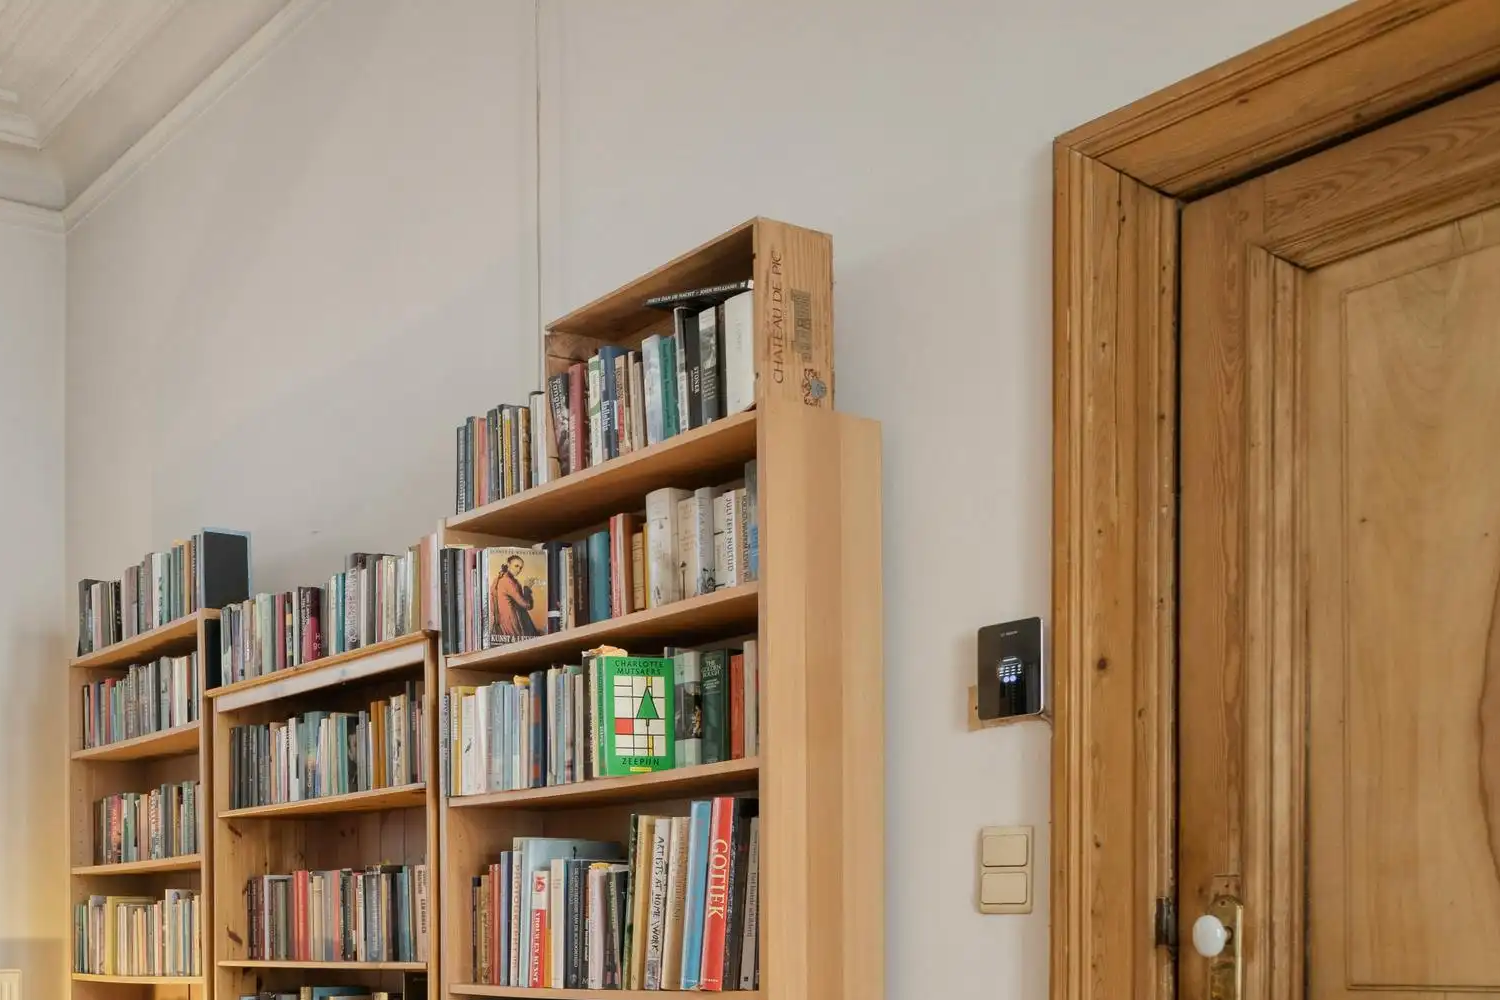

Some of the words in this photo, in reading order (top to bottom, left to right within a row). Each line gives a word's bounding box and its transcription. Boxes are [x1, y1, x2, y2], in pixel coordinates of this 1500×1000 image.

[771, 281, 782, 303] DE
[772, 308, 784, 384] CHATEAU
[725, 497, 733, 515] JULI
[725, 518, 733, 534] ZEH
[614, 659, 665, 668] CHARLOTTE
[616, 667, 661, 676] MUTSAERS
[654, 836, 665, 876] ARTISTS
[654, 878, 663, 890] AT
[707, 838, 728, 920] GOTIEK
[653, 893, 662, 918] HOME
